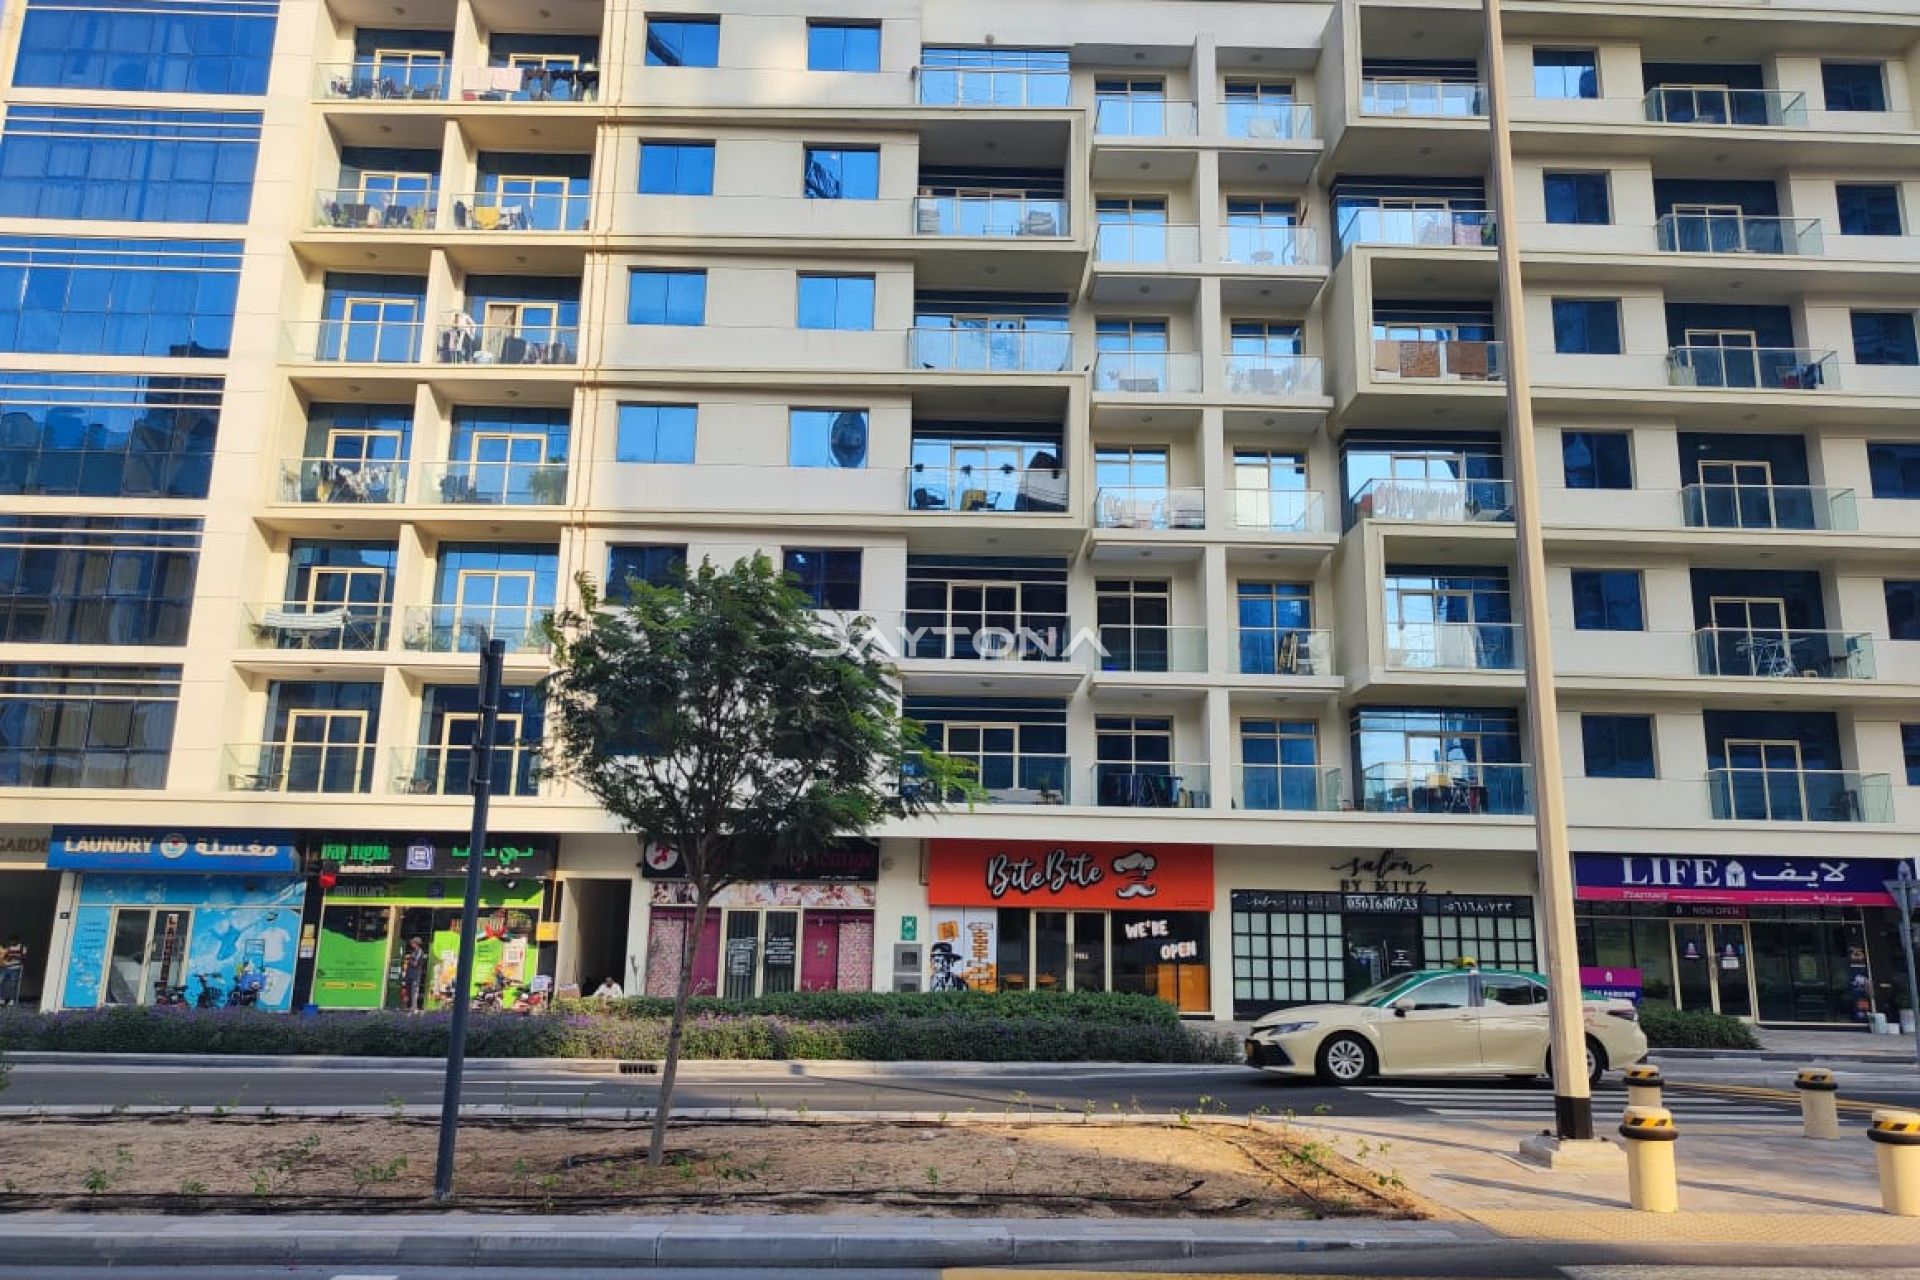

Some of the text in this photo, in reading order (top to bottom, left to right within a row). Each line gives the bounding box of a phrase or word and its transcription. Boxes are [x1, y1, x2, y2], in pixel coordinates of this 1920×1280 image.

[64, 835, 153, 854] LAUNDRY
[195, 838, 278, 857] مغسلة
[1621, 857, 1721, 886] LIFE
[1752, 862, 1850, 887] لايف
[1340, 880, 1428, 894] BY MITZ
[1125, 919, 1169, 940] WE'RE
[1160, 940, 1198, 960] OPEN
